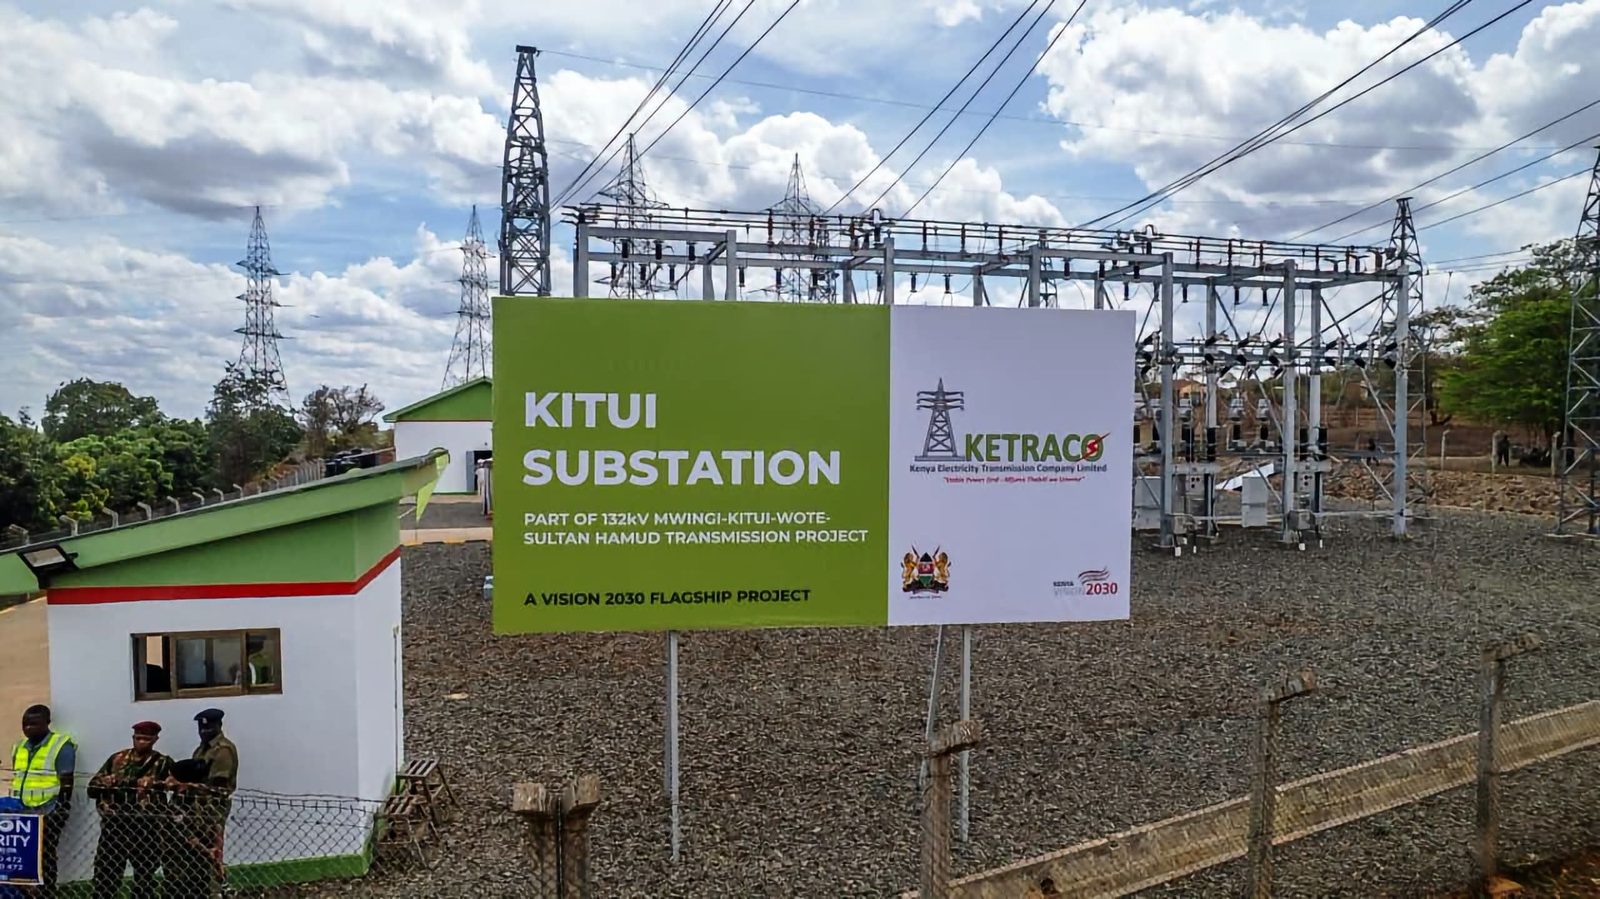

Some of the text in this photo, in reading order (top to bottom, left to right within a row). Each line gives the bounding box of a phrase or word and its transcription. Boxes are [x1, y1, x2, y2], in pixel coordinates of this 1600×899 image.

[524, 392, 657, 428] KITUI
[965, 433, 1104, 462] KETRACO
[522, 450, 841, 486] SUBSTATION
[910, 463, 1107, 474] Kenya Electricity Transmission Company Limited
[524, 512, 831, 526] PART OF 132kV MWINGI-KITUI-WOTE-
[523, 530, 869, 545] SULTAN HAMUD TRANSMISSION PROJECT
[1086, 583, 1118, 595] 2030
[524, 589, 811, 606] A VISION 2030 FLAGSHIP PROJECT
